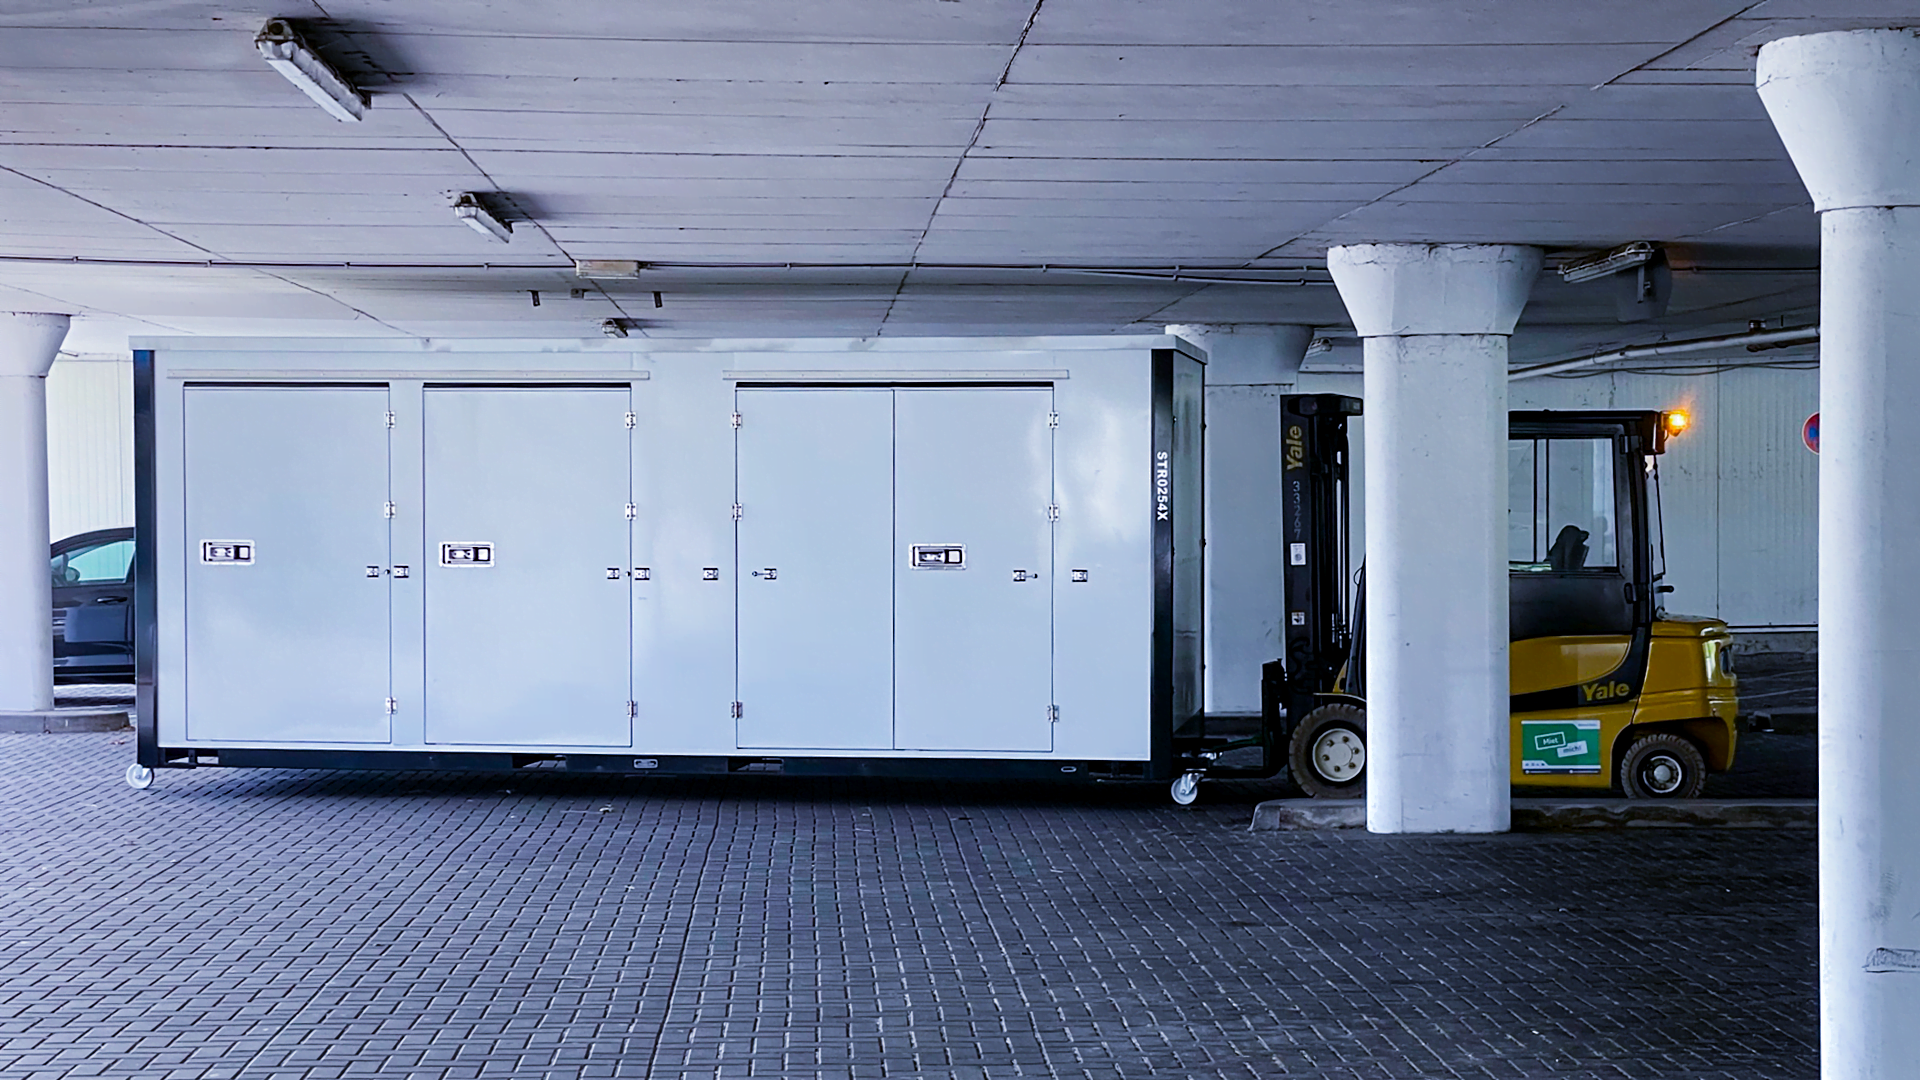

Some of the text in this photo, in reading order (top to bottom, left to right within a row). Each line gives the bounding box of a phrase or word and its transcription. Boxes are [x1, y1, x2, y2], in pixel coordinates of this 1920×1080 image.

[1286, 425, 1303, 470] Yale
[1156, 451, 1169, 521] STR0254X
[1582, 681, 1630, 701] Yale
